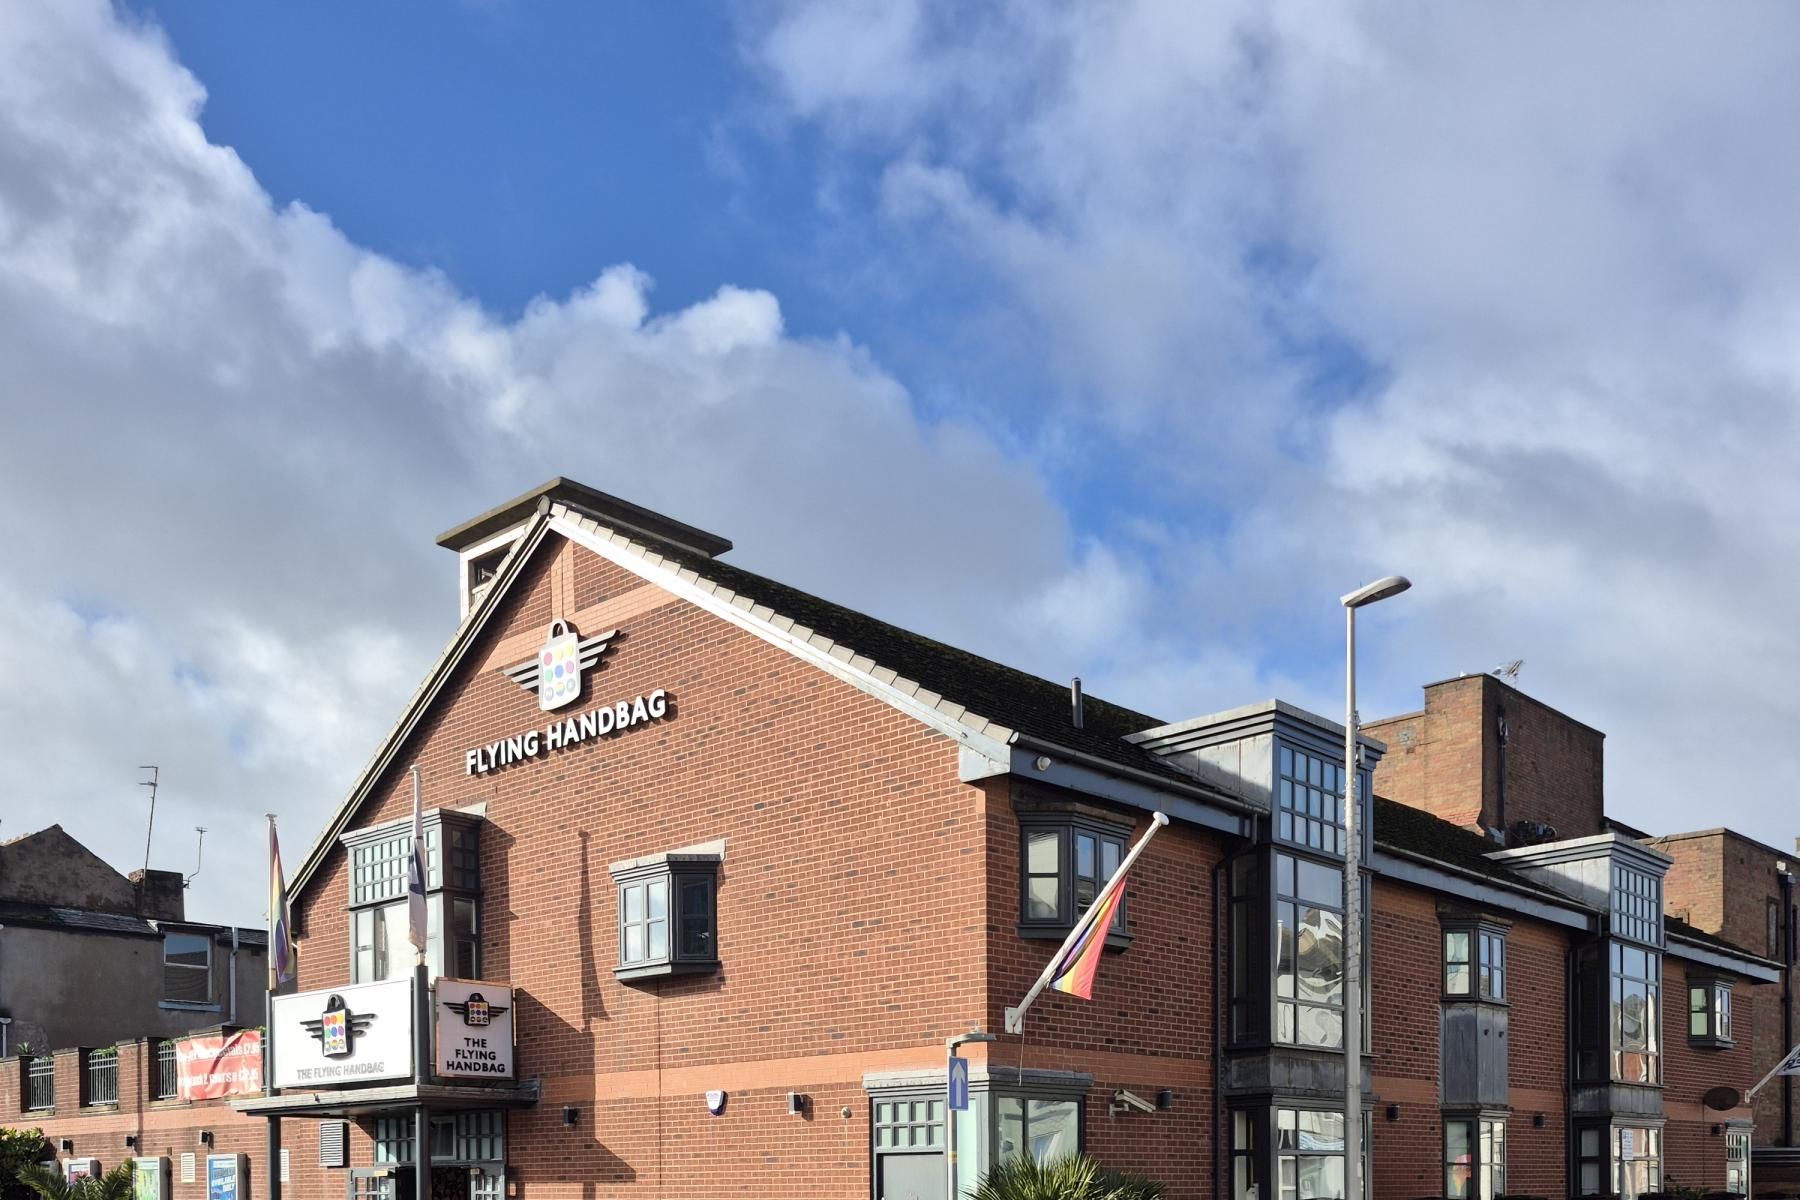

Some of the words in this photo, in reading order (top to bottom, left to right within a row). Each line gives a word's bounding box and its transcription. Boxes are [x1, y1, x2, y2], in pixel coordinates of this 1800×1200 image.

[466, 731, 538, 775] FLYING
[547, 689, 666, 750] HANDBAG
[464, 1037, 487, 1048] THE
[455, 1048, 496, 1060] FLYING
[296, 1068, 312, 1080] THE
[313, 1065, 342, 1078] FLYING
[343, 1062, 385, 1076] HANDBAG
[446, 1060, 505, 1073] HANDBAG
